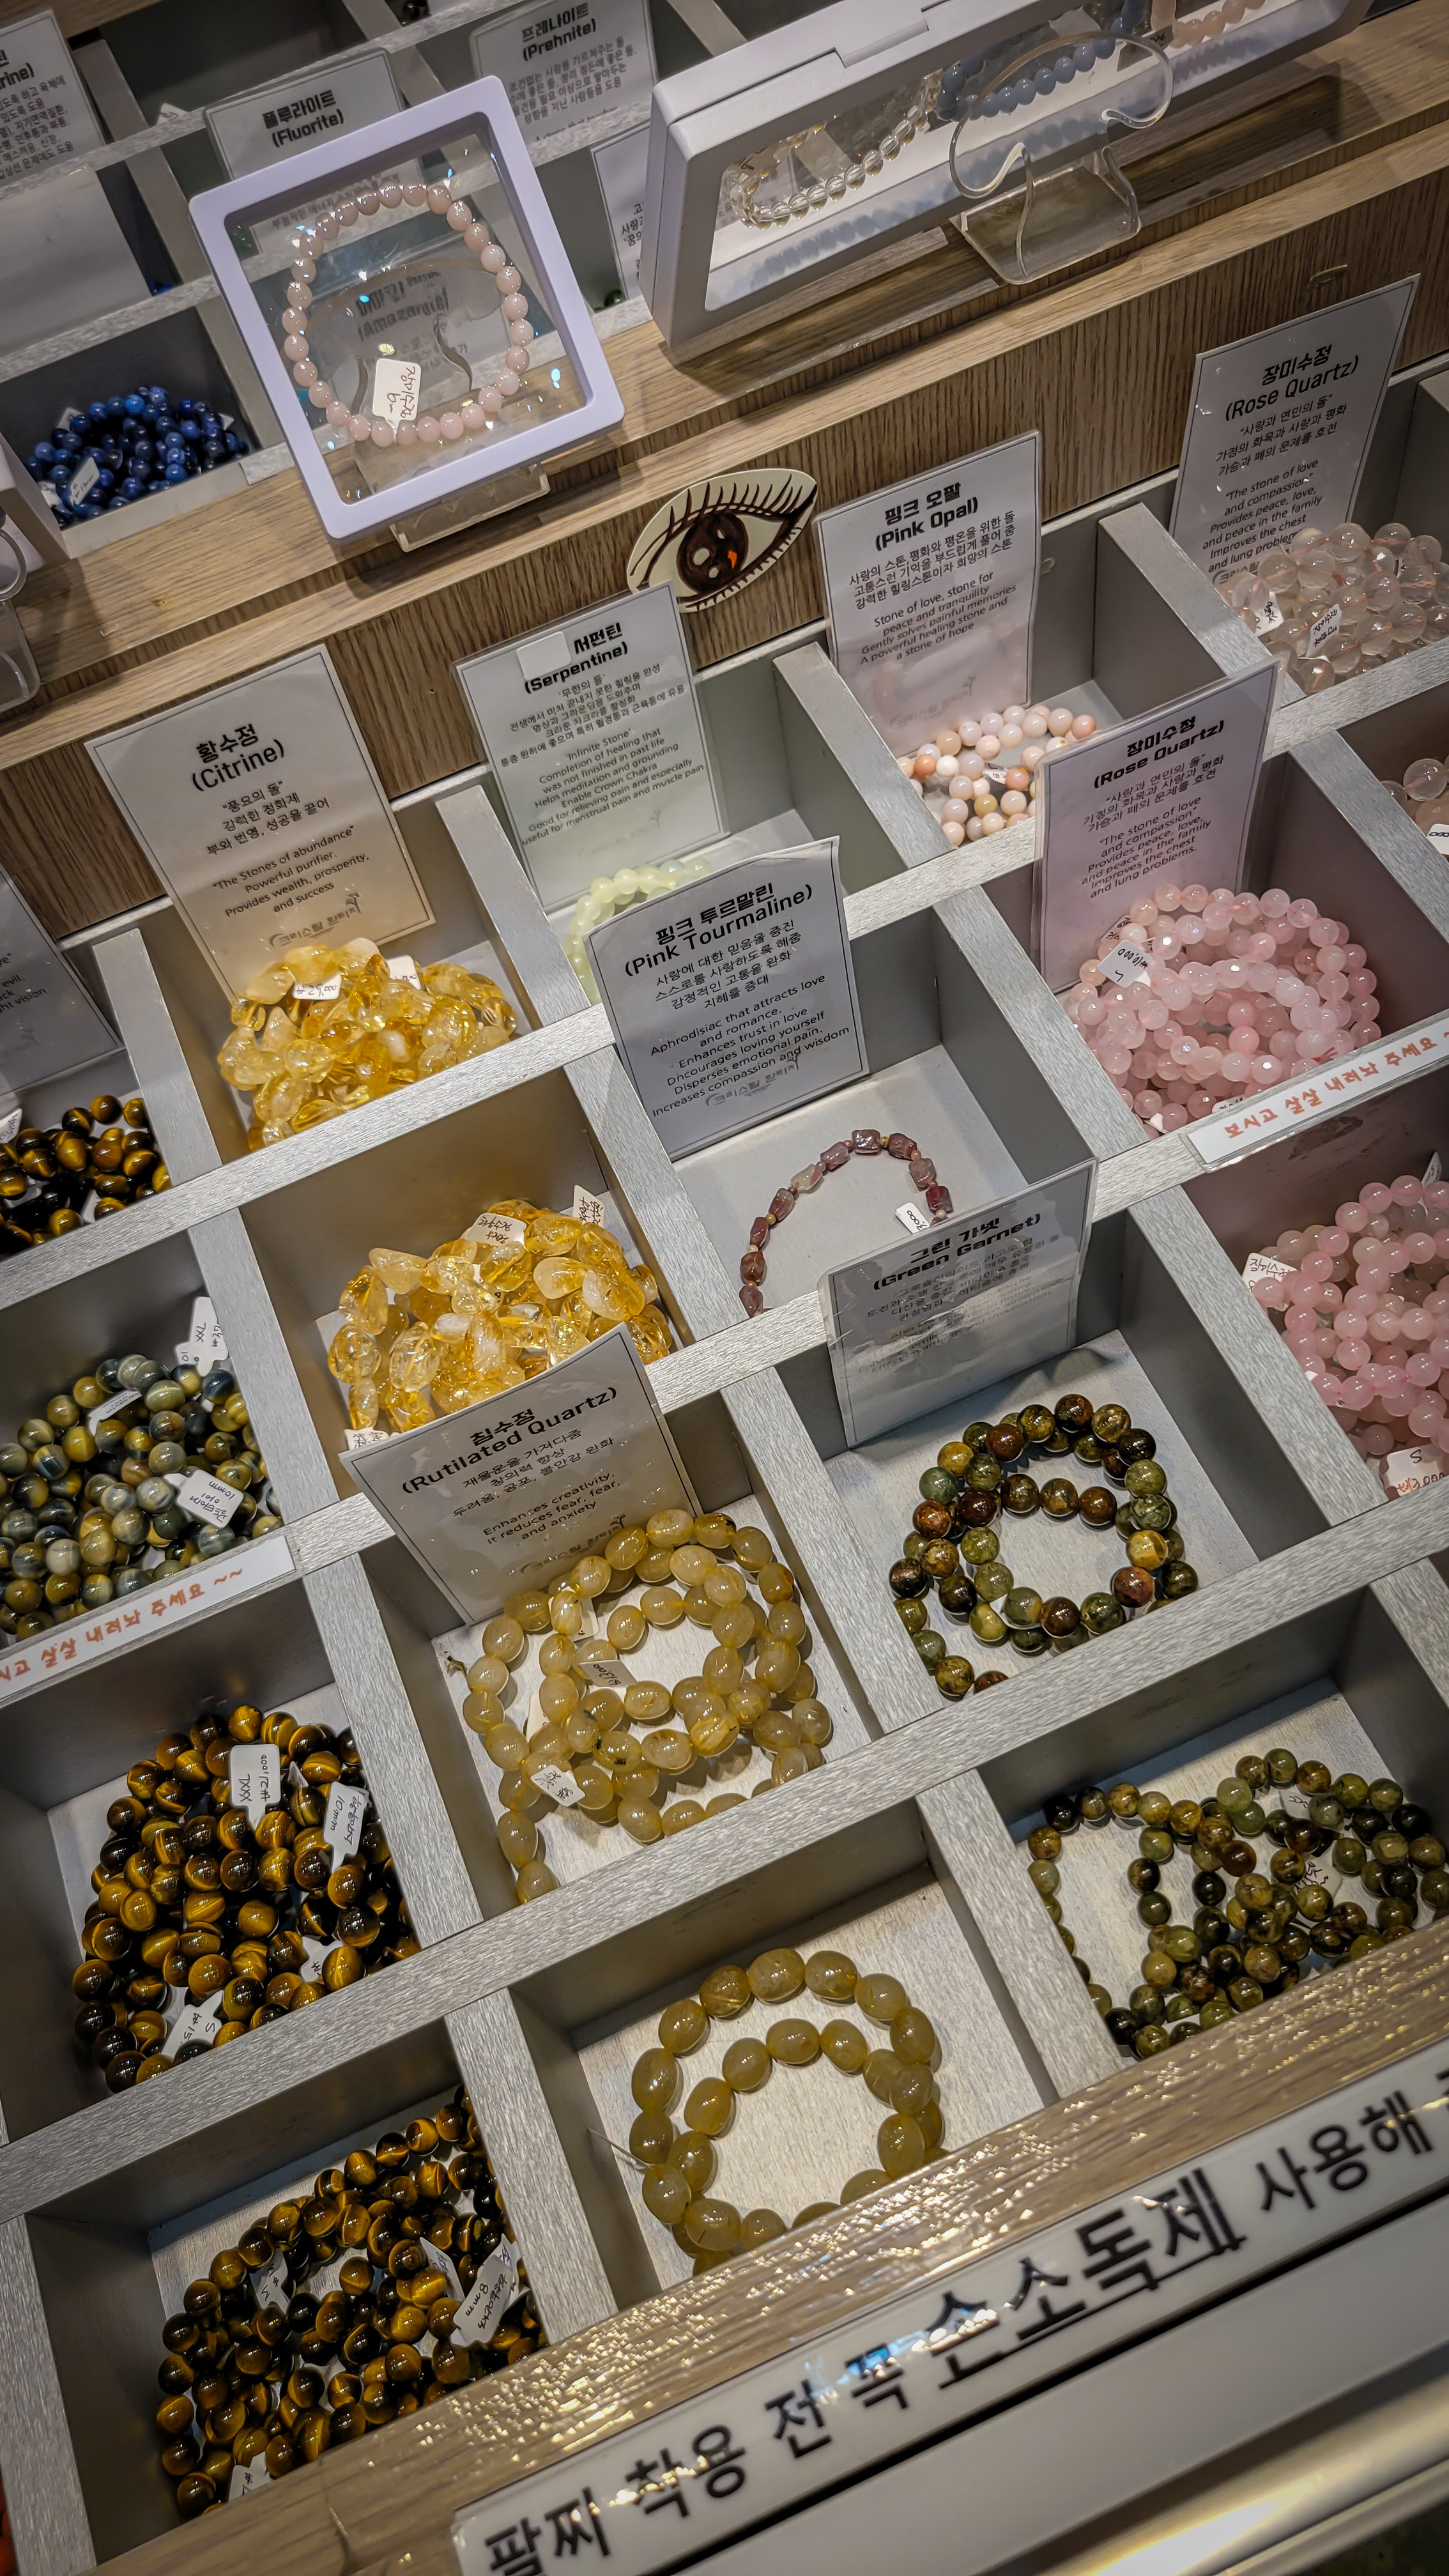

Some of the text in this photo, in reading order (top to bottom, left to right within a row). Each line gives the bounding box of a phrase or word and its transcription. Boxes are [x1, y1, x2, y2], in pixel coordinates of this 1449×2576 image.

[522, 17, 596, 62] (Prehnite)
[271, 108, 344, 148] (Fluorite)
[1225, 355, 1359, 422] (Rose Quartz)
[1261, 343, 1332, 386] 장미수정
[1249, 474, 1280, 493] stone
[1282, 465, 1295, 479] of
[1296, 459, 1319, 474] love
[875, 496, 978, 552] (Pink Opal)
[884, 481, 961, 526] 핑크 오팔
[848, 564, 881, 586] 사랑의
[944, 526, 977, 548] 평온을
[979, 515, 1001, 533] 위한
[1003, 510, 1015, 525] 돌
[1209, 514, 1307, 559] Improves the chest
[873, 571, 993, 627] Stone of love, stone for
[573, 622, 623, 655] 서펀틴
[524, 640, 628, 694] (Serpentine)
[195, 723, 259, 763] 황수정
[1093, 719, 1224, 789] (Rose Quartz)
[1126, 715, 1195, 758] 장미수정
[192, 738, 284, 792] (Citrine)
[533, 743, 679, 809] Helps meditation and grounding
[560, 763, 657, 808] Enable Crown Chakra
[222, 792, 300, 832] 강력한 정화제
[1127, 816, 1159, 836] stone
[1162, 806, 1175, 819] of
[1177, 797, 1201, 812] love
[239, 860, 277, 880] Stones
[279, 852, 291, 864] of
[1087, 847, 1134, 873] Provides
[1137, 830, 1173, 851] peace,
[1089, 846, 1196, 898] and lung problems.
[224, 853, 369, 917] Provides wealth, prosperity,
[273, 882, 335, 912] and success
[624, 884, 812, 977] (Pink Tourmaline)
[655, 882, 774, 946] 핑크 투르말린
[656, 918, 794, 986] 사랑에 대한 믿음을 증진
[650, 975, 825, 1056] Aphrodisiac that attracts love
[678, 1008, 808, 1068] Enhances trust in love
[652, 1027, 849, 1117] Increases compassion and wisdom
[1223, 1107, 1279, 1138] 보시고
[1284, 1087, 1322, 1116] 살살
[1383, 1036, 1438, 1066] 주세요
[873, 1213, 1041, 1291] (Green Garnet)
[910, 1216, 1000, 1264] 그린 가넷
[401, 1386, 617, 1494] (Rutilated Quartz)
[469, 1407, 535, 1446] 침수정
[462, 1428, 581, 1488] 재물운을 가져다줌
[1409, 1448, 1422, 1464] S
[487, 1536, 497, 1545] It
[521, 1500, 596, 1540] and anxiety
[41, 1637, 78, 1669] 살살
[151, 1582, 206, 1616] 주세요
[484, 2487, 612, 2575] 팔찌
[626, 2424, 747, 2518] 착용
[764, 2379, 833, 2459] 전
[925, 2167, 1247, 2390] 손소독제
[1255, 2089, 1434, 2212] 사용해
